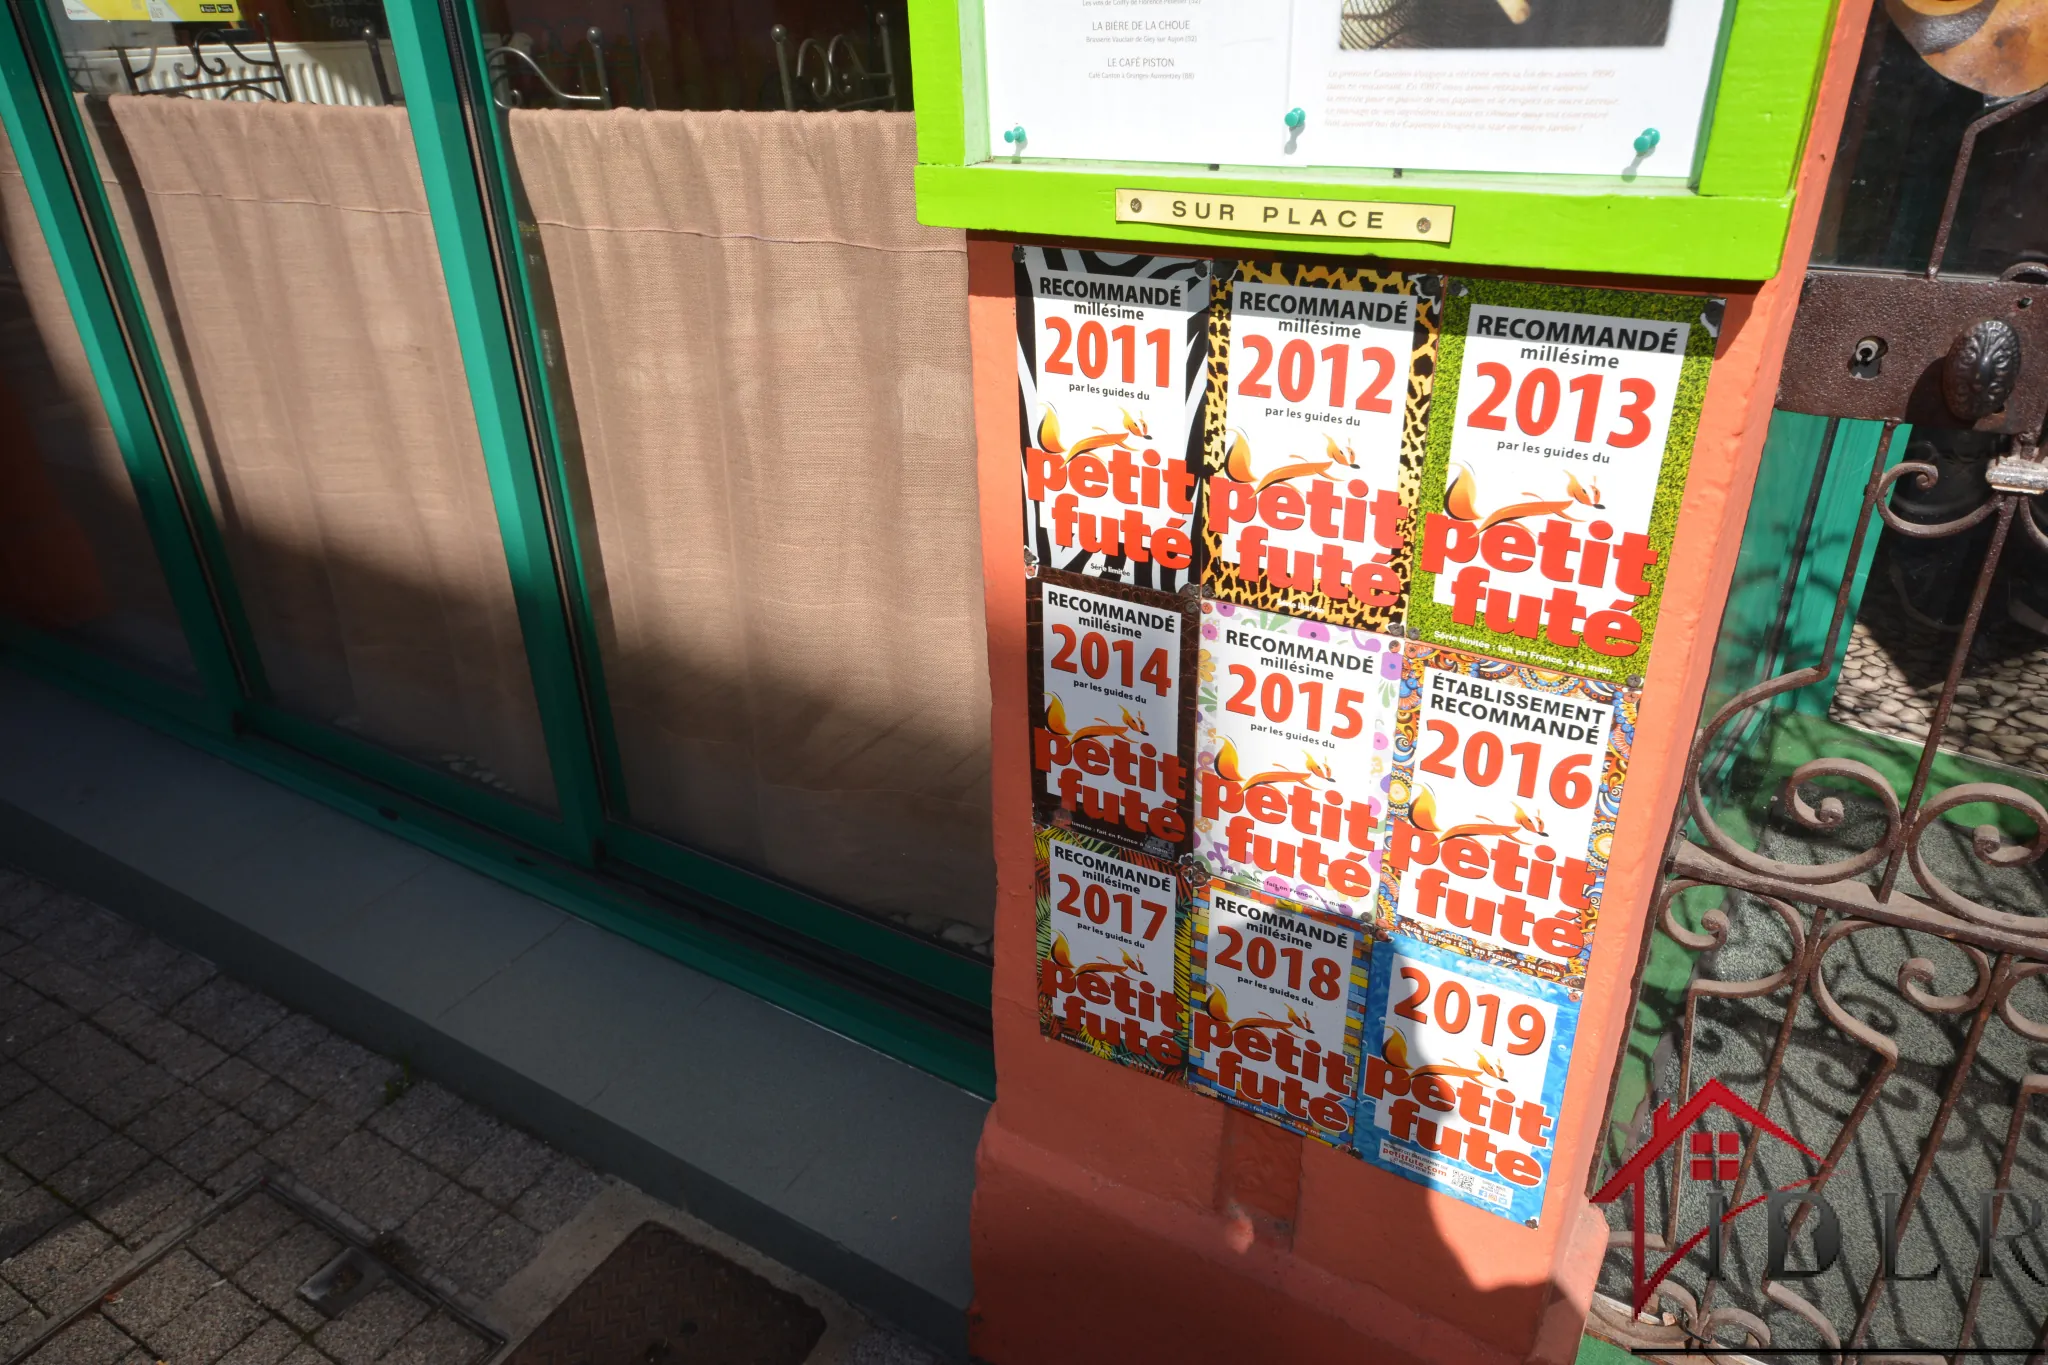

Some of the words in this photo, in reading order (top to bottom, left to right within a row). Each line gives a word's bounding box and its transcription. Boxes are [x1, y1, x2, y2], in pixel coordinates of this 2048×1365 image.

[1092, 21, 1103, 31] LA
[1131, 21, 1143, 31] DE
[1145, 20, 1157, 30] LA
[1158, 20, 1191, 30] CHOUE
[1107, 58, 1117, 67] LE
[1119, 56, 1140, 67] CAFÉ
[1142, 58, 1175, 67] PISTON
[1172, 200, 1235, 221] SUR
[1263, 206, 1384, 229] PLACE
[1039, 276, 1182, 307] RECOMMANDÉ
[1074, 301, 1145, 321] millésime
[1239, 291, 1409, 325] RECOMMANDÉ
[1044, 316, 1171, 388] 2011
[1278, 318, 1362, 340] millésime
[1476, 315, 1679, 353] RECOMMANDÉ
[1238, 334, 1396, 414] 2012
[1520, 345, 1619, 369] millésime
[1068, 382, 1085, 395] par
[1086, 383, 1100, 394] les
[1102, 386, 1136, 401] guides
[1137, 389, 1150, 401] du
[1265, 407, 1284, 420] par
[1286, 407, 1302, 420] les
[1304, 410, 1343, 427] guides
[1345, 414, 1361, 427] du
[1466, 361, 1657, 449] 2013
[1497, 439, 1519, 453] par
[1522, 440, 1540, 455] les
[1544, 444, 1589, 463] guides
[1592, 450, 1610, 464] du
[1026, 447, 1195, 514] petit
[1051, 492, 1193, 570] futé
[1208, 476, 1409, 550] petit
[1236, 525, 1401, 608] futé
[1420, 512, 1659, 596] petit
[1048, 590, 1176, 633] RECOMMANDÉ
[1078, 615, 1142, 639] millésime
[1450, 565, 1644, 657] futé
[1051, 623, 1172, 697] 2014
[1225, 629, 1374, 675] RECOMMANDÉ
[1260, 655, 1335, 681] millésime
[1434, 630, 1458, 642] Série
[1459, 635, 1491, 649] limitée
[1497, 644, 1514, 654] fait
[1516, 649, 1528, 657] en
[1576, 661, 1586, 670] la
[1588, 664, 1613, 675] main
[1073, 679, 1088, 692] par
[1089, 681, 1102, 693] les
[1103, 685, 1134, 702] guides
[1135, 692, 1147, 704] du
[1225, 663, 1365, 740] 2015
[1432, 672, 1606, 725] ÉTABLISSEMENT
[1250, 721, 1267, 735] par
[1269, 725, 1283, 737] les
[1285, 729, 1321, 747] guides
[1322, 737, 1336, 749] du
[1430, 693, 1599, 745] RECOMMANDÉ
[1034, 726, 1187, 800] petit
[1419, 719, 1593, 809] 2016
[1057, 767, 1186, 843] futé
[1201, 771, 1379, 852] petit
[1054, 845, 1171, 892] RECOMMANDÉ
[1082, 869, 1140, 895] millésime
[1225, 815, 1372, 898] futé
[1388, 818, 1597, 911] petit
[1057, 873, 1167, 942] 2017
[1215, 896, 1348, 949] RECOMMANDÉ
[1414, 867, 1584, 958] futé
[1077, 921, 1091, 933] par
[1092, 925, 1104, 936] les
[1105, 929, 1132, 947] guides
[1133, 937, 1145, 949] du
[1246, 921, 1313, 950] millésime
[1400, 922, 1422, 936] Série
[1423, 928, 1452, 945] limitée
[1458, 939, 1473, 953] fait
[1474, 947, 1486, 956] en
[1487, 949, 1518, 964] France
[1527, 961, 1536, 970] la
[1537, 965, 1561, 977] main
[1214, 925, 1341, 1001] 2018
[1041, 957, 1184, 1031] petit
[1237, 975, 1253, 988] par
[1254, 979, 1267, 991] les
[1269, 984, 1300, 1003] guides
[1301, 995, 1314, 1007] du
[1393, 966, 1546, 1056] 2019
[1063, 995, 1182, 1066] futé
[1192, 1010, 1354, 1096] petit
[1216, 1050, 1350, 1132] futé
[1363, 1055, 1552, 1148] petit
[1382, 1147, 1447, 1177] petitfute.com
